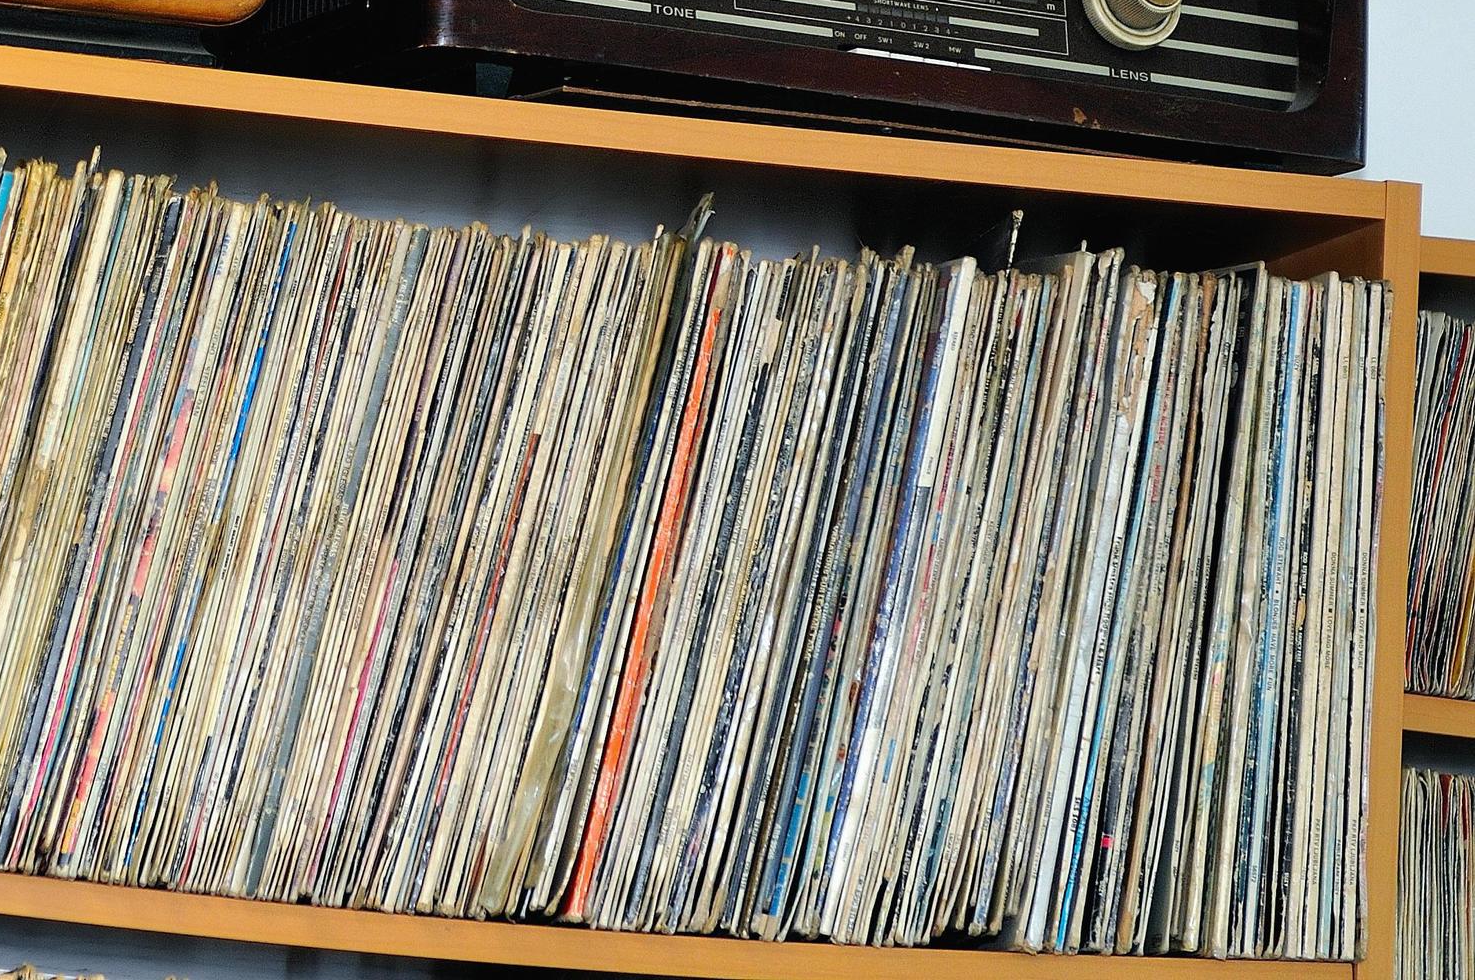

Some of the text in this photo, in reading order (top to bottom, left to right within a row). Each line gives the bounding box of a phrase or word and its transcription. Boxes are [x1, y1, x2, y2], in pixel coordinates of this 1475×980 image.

[653, 4, 694, 19] TONE
[913, 3, 930, 11] LENS
[1046, 3, 1056, 11] m
[834, 30, 962, 54] ON OFF MW
[1111, 68, 1149, 82] LENS
[149, 266, 162, 293] STEREO
[111, 360, 128, 400] GREATEST
[191, 397, 202, 417] DAN
[745, 417, 755, 433] JONI
[737, 433, 752, 467] MITCHELL
[747, 423, 763, 472] MADONNA
[925, 455, 934, 475] PRINCE
[337, 501, 350, 524] JULIO
[327, 524, 344, 558] IGLESIAS
[822, 524, 839, 573] VARIATIONS
[1112, 535, 1123, 560] Frank
[1274, 553, 1283, 585] STEWART
[1328, 551, 1337, 576] DONNA
[1360, 551, 1368, 575] DONNA
[1299, 564, 1307, 589] STEWART
[1326, 576, 1335, 606] SUMMER
[1358, 575, 1367, 606] SUMMER
[1270, 598, 1279, 631] BLONDES
[1325, 615, 1333, 632] LOVE
[1357, 615, 1365, 633] LOVE
[1356, 634, 1364, 649] AND
[1094, 655, 1103, 675] Hart
[1267, 653, 1275, 674] MORE
[1323, 649, 1331, 670] MORE
[1356, 650, 1364, 669] MORE
[1313, 817, 1321, 833] PKP
[1312, 832, 1320, 846] RTV
[1349, 833, 1357, 847] RTV
[1310, 846, 1319, 885] LJUBLJANA
[1347, 847, 1356, 886] LJUBLJANA
